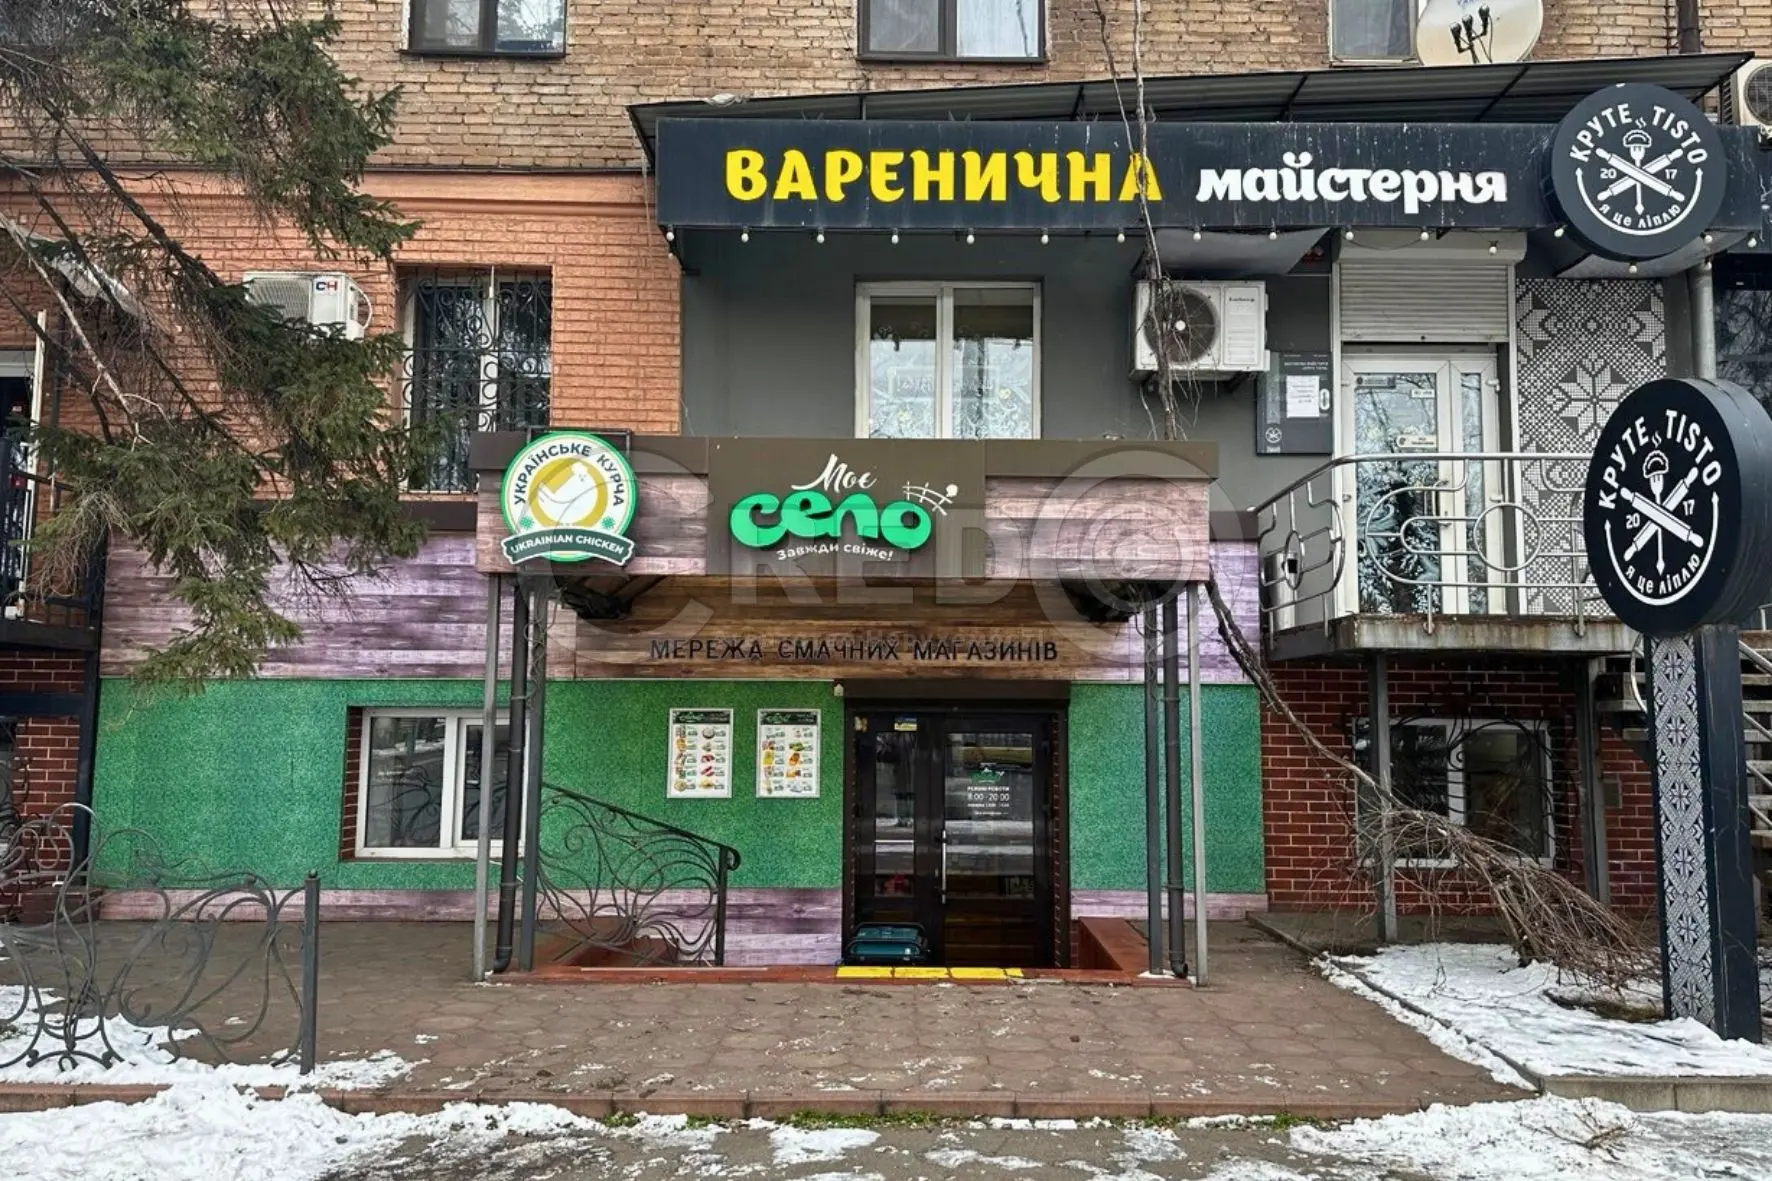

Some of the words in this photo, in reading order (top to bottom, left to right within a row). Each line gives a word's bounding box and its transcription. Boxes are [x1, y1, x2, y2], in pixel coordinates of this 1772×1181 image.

[1569, 103, 1632, 163] КРУТЕ
[724, 149, 1163, 203] ВАРЕНИЧНА
[1195, 152, 1509, 214] майстерня
[1599, 168, 1617, 180] 20
[1665, 168, 1678, 180] 17
[1612, 211, 1632, 227] це
[1637, 203, 1681, 229] ліплю
[315, 281, 338, 291] CH
[514, 442, 592, 505] УКРАЇНСЬКЕ
[596, 454, 625, 507] КУРЧА
[1598, 416, 1650, 509] КРУТЕ
[1625, 513, 1641, 529] 20
[1683, 499, 1696, 516] 17
[510, 534, 574, 555] UKRAINIAN
[575, 535, 625, 555] CHICKEN
[776, 542, 844, 561] Завжди
[843, 542, 894, 561] свіже!
[1636, 574, 1654, 594] це
[1658, 553, 1700, 595] ліплю
[650, 639, 764, 660] МЕРЕЖА
[777, 639, 899, 661] СМАЧНИХ
[912, 640, 1059, 661] МАГАЗИНІВ
